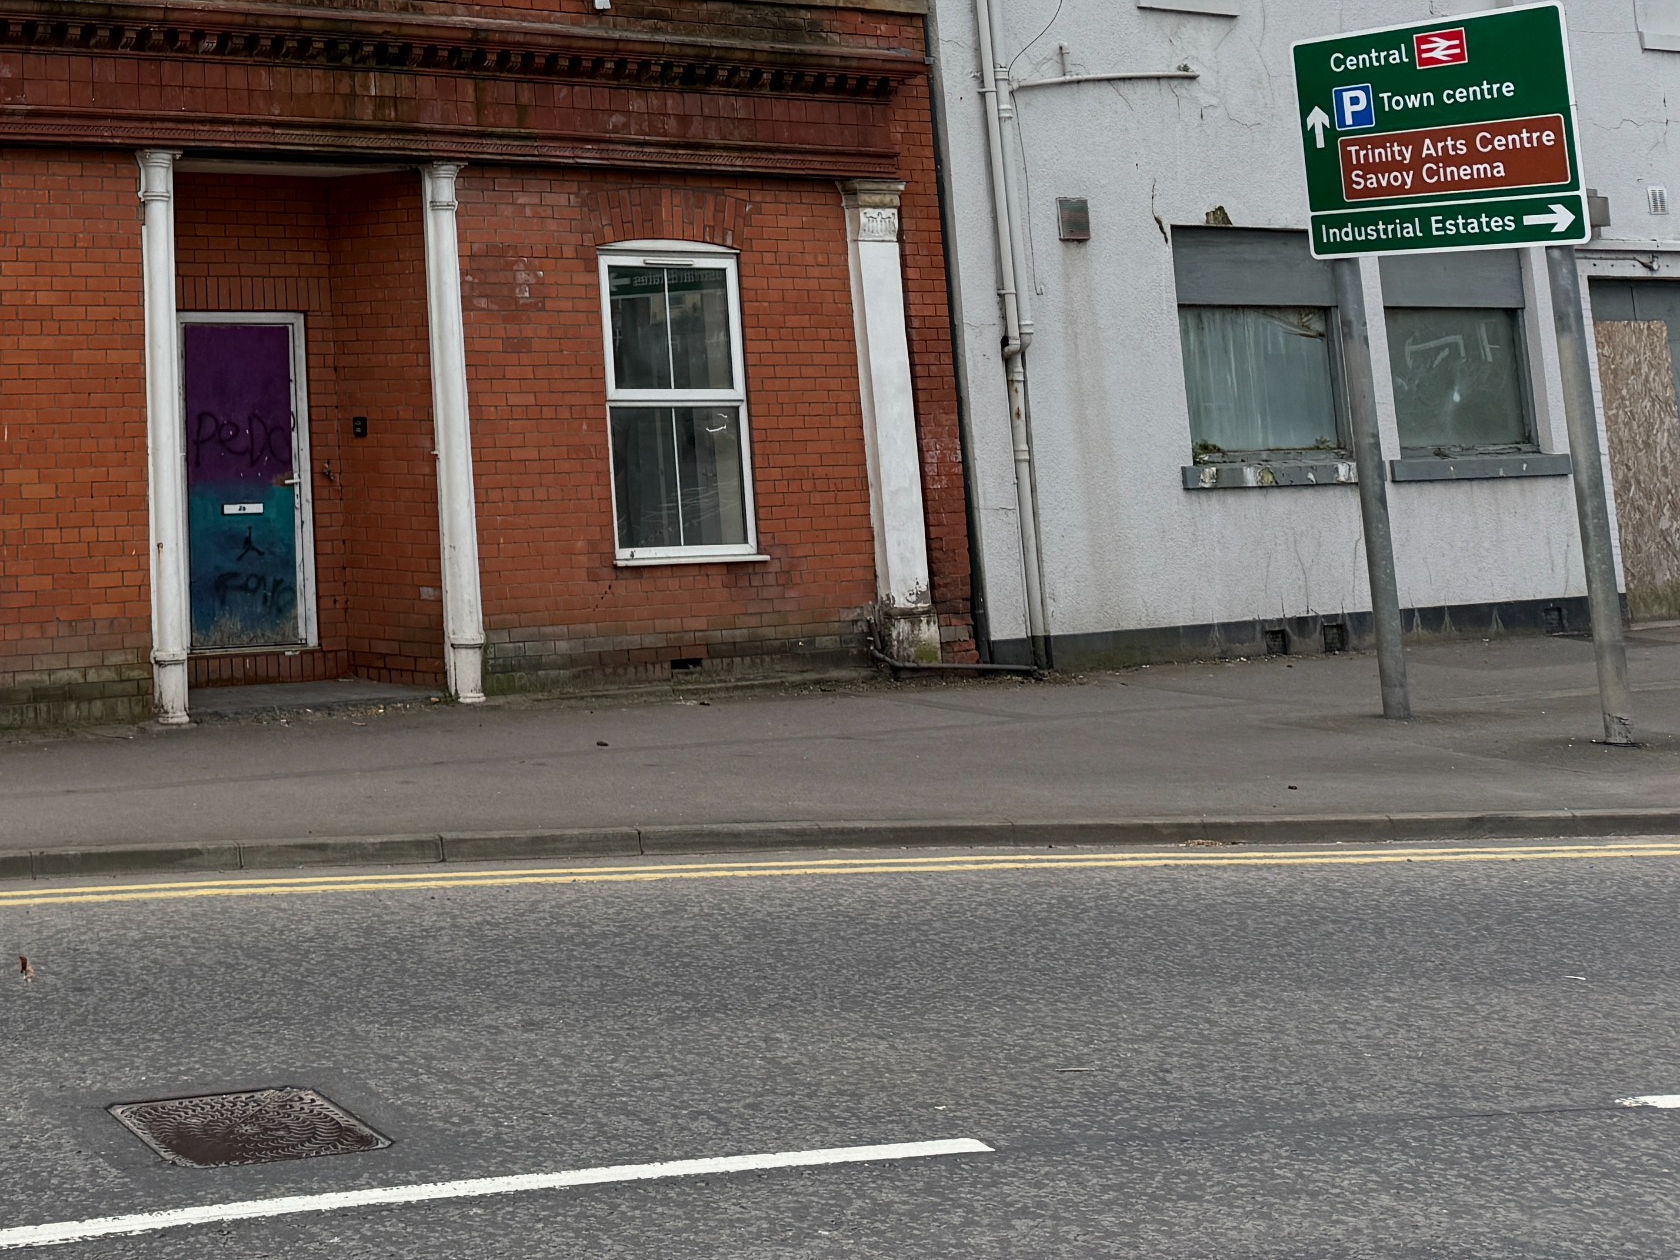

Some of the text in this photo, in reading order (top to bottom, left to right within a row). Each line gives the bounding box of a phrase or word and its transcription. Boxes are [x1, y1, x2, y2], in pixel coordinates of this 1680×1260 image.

[1330, 42, 1409, 72] Central
[1342, 89, 1367, 126] P
[1379, 80, 1515, 112] Town centre
[1346, 128, 1556, 165] Trinity Arts Centre
[1351, 161, 1506, 190] Savoy Cinema
[1321, 213, 1516, 243] Industrial Estates
